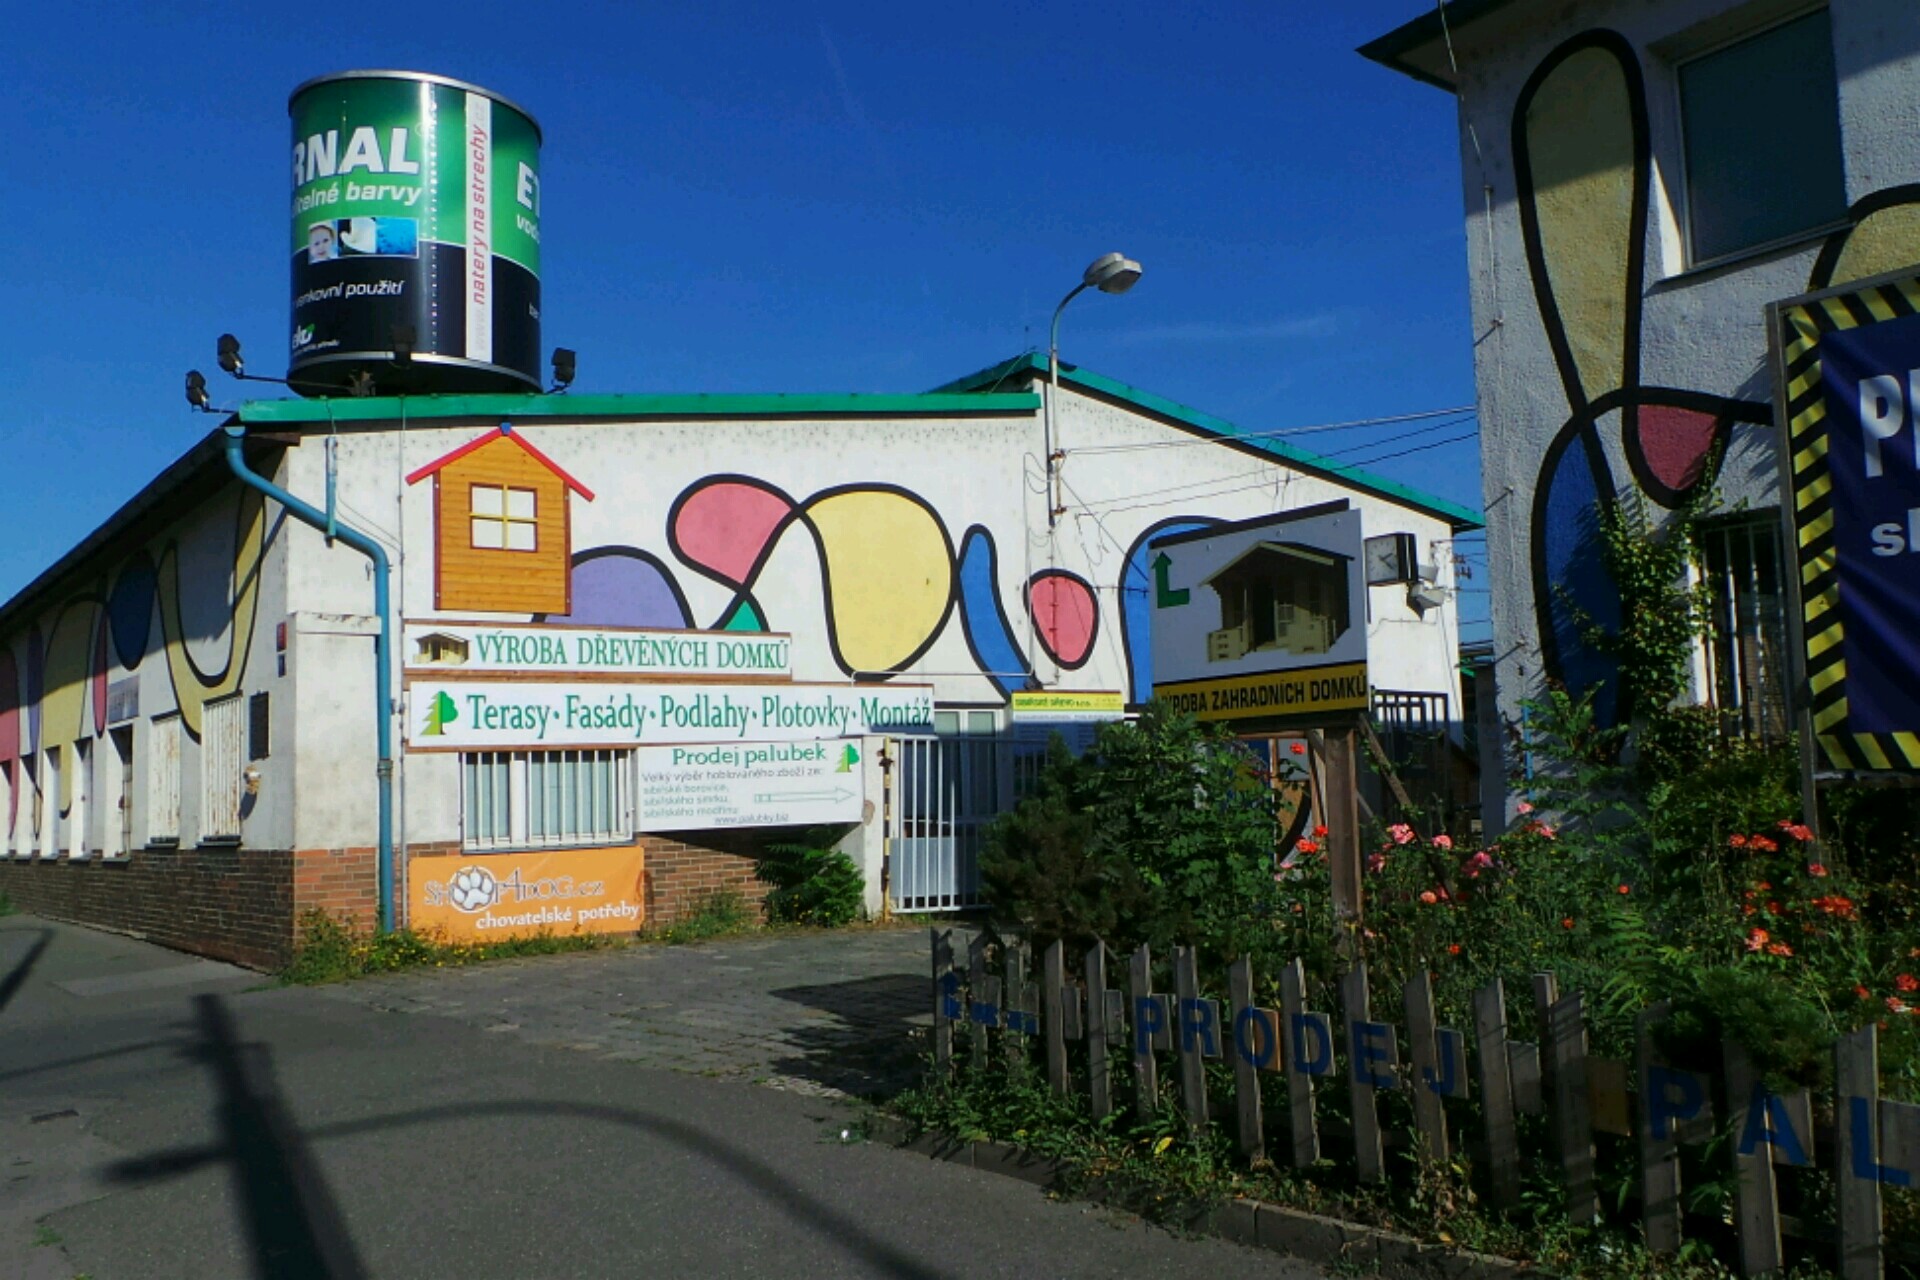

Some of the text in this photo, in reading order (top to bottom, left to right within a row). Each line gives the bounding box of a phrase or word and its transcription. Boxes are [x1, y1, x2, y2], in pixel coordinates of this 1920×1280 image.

[345, 181, 422, 206] barvy
[345, 280, 405, 299] použití
[1858, 370, 1920, 480] P
[475, 630, 790, 669] VÝROBA DŘEVĚNÝCH DOMKŮ
[1212, 679, 1305, 711] ZAHRADNÍCH
[466, 692, 933, 739] Terasy Fasády Podlahy Plotovky Montáž
[672, 743, 826, 768] Prodej palubek
[476, 900, 641, 930] chovatelské potřeby
[1134, 995, 1457, 1096] PRODEJ
